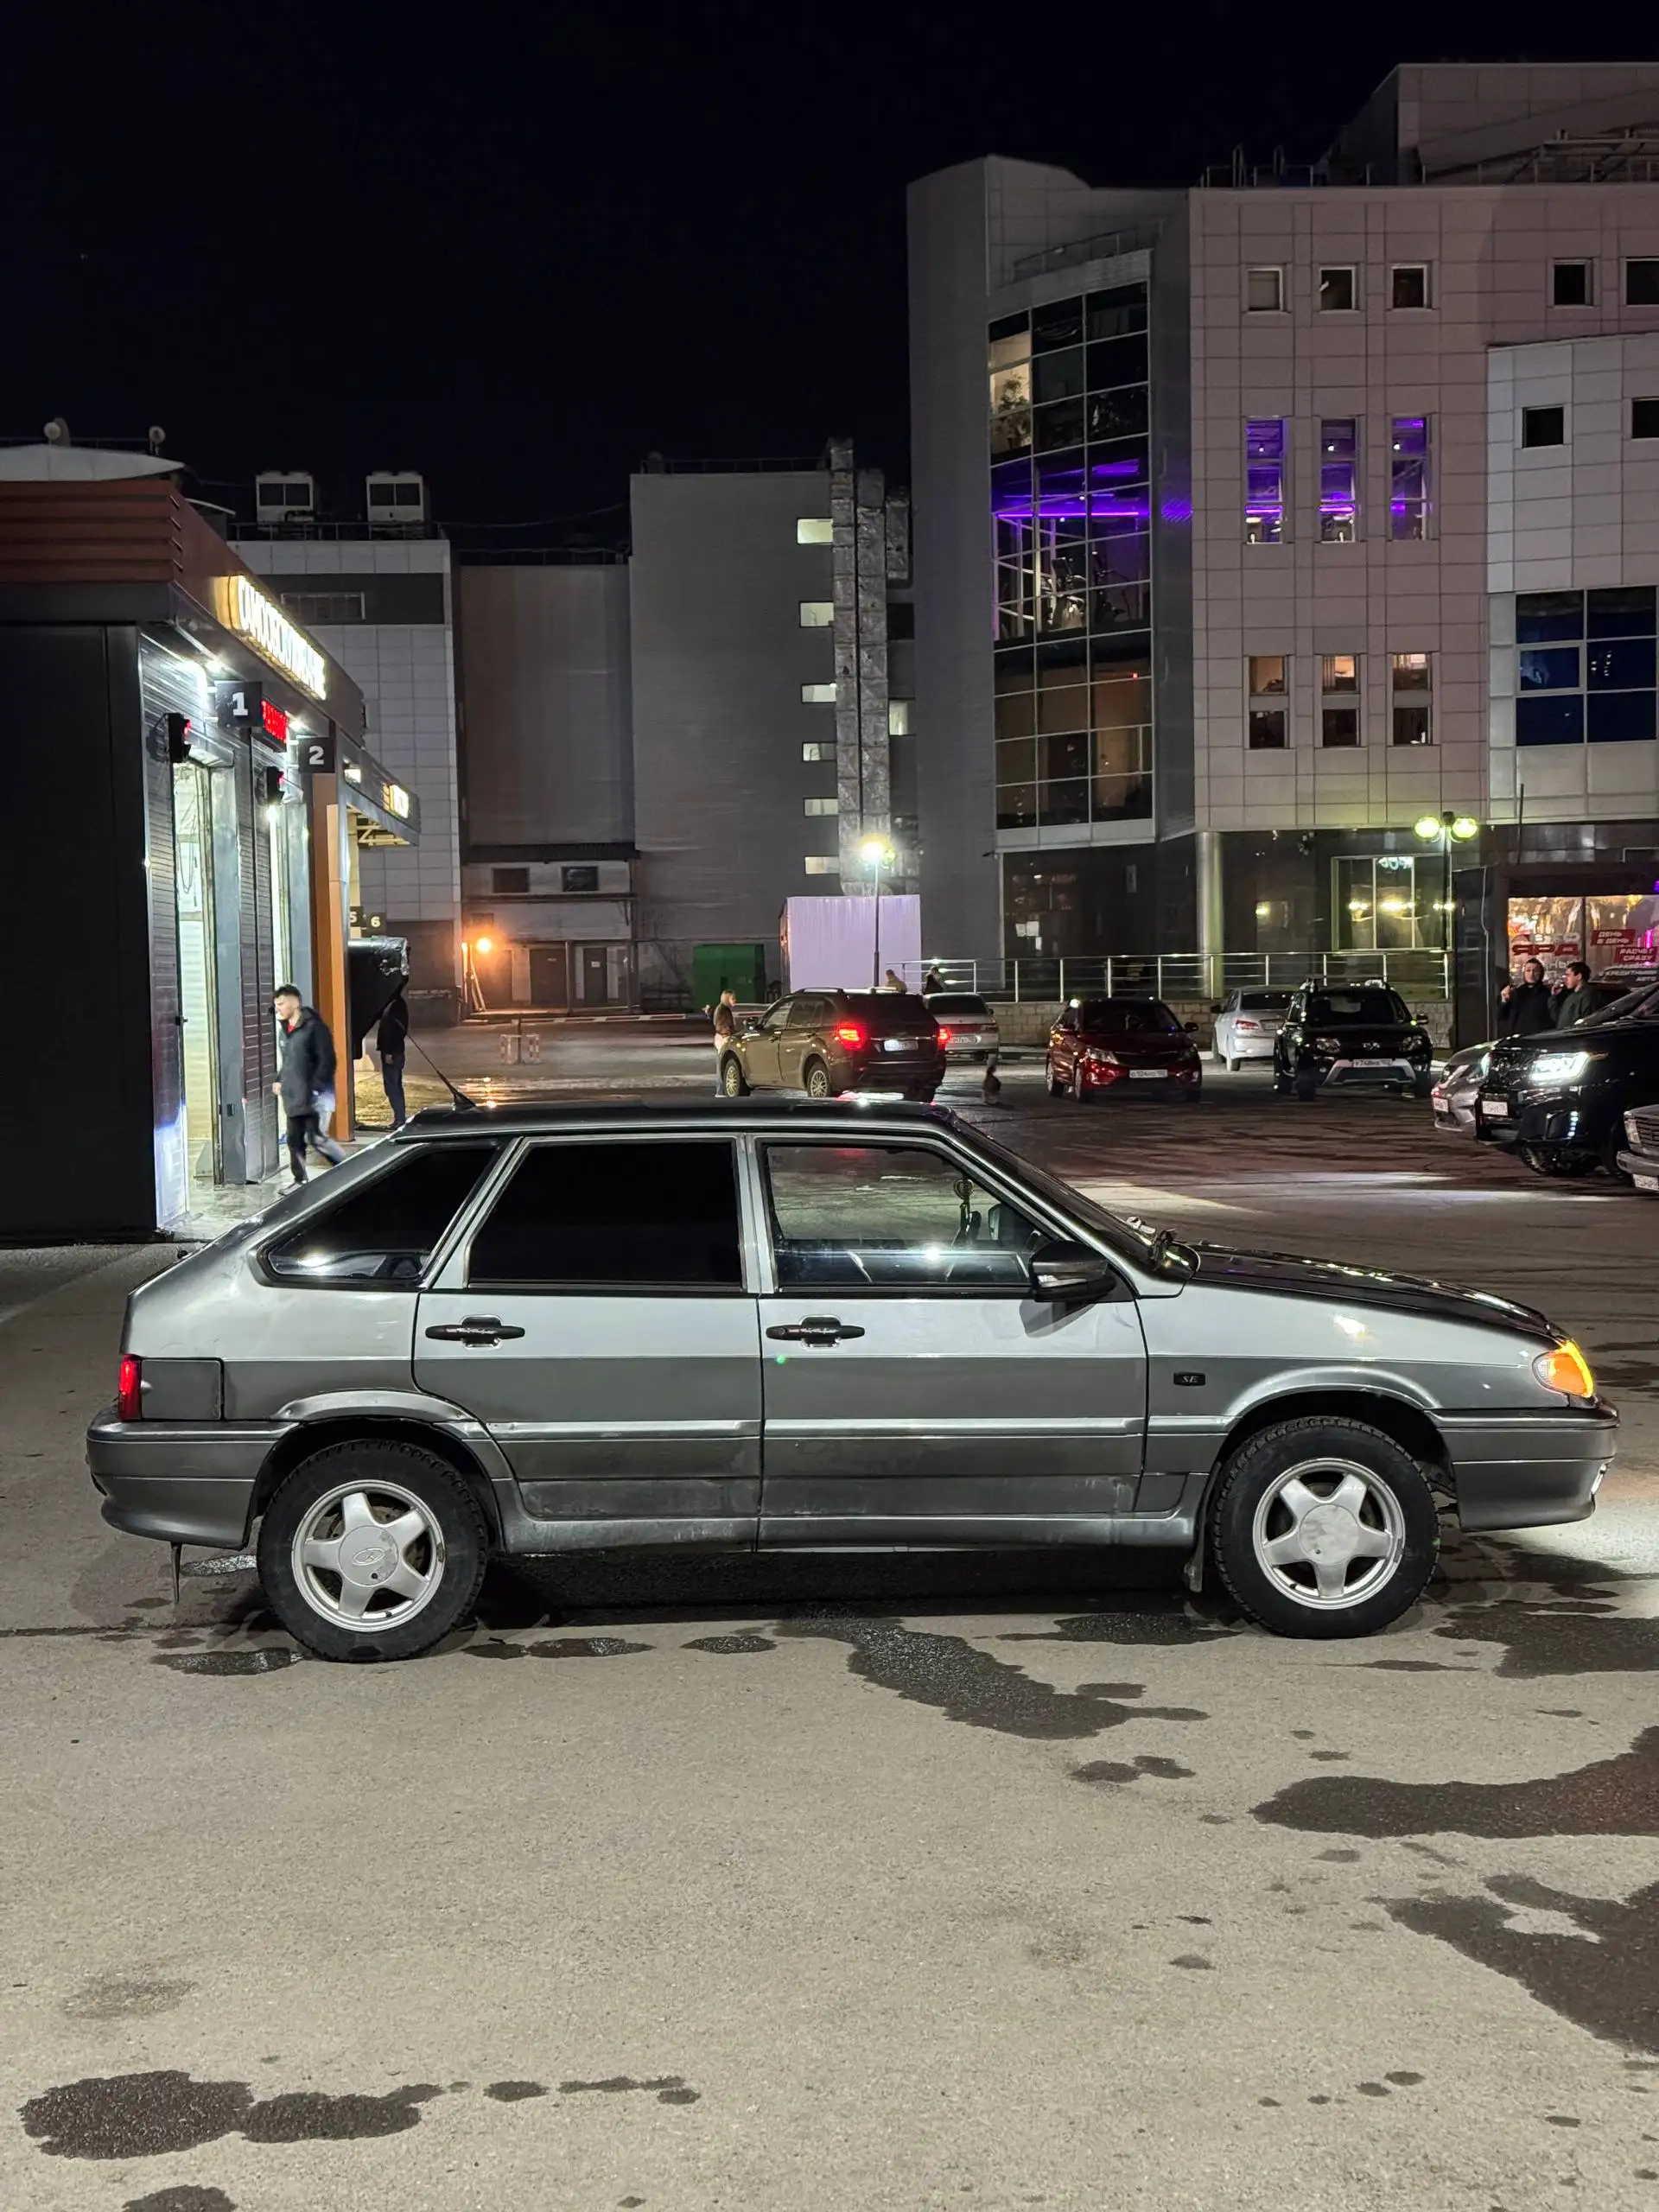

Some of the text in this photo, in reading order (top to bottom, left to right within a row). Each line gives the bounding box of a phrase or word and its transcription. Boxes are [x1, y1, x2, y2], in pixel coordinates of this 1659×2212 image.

[232, 691, 248, 715] 1
[308, 746, 324, 765] 2
[349, 912, 357, 923] 5
[371, 916, 380, 927] 6
